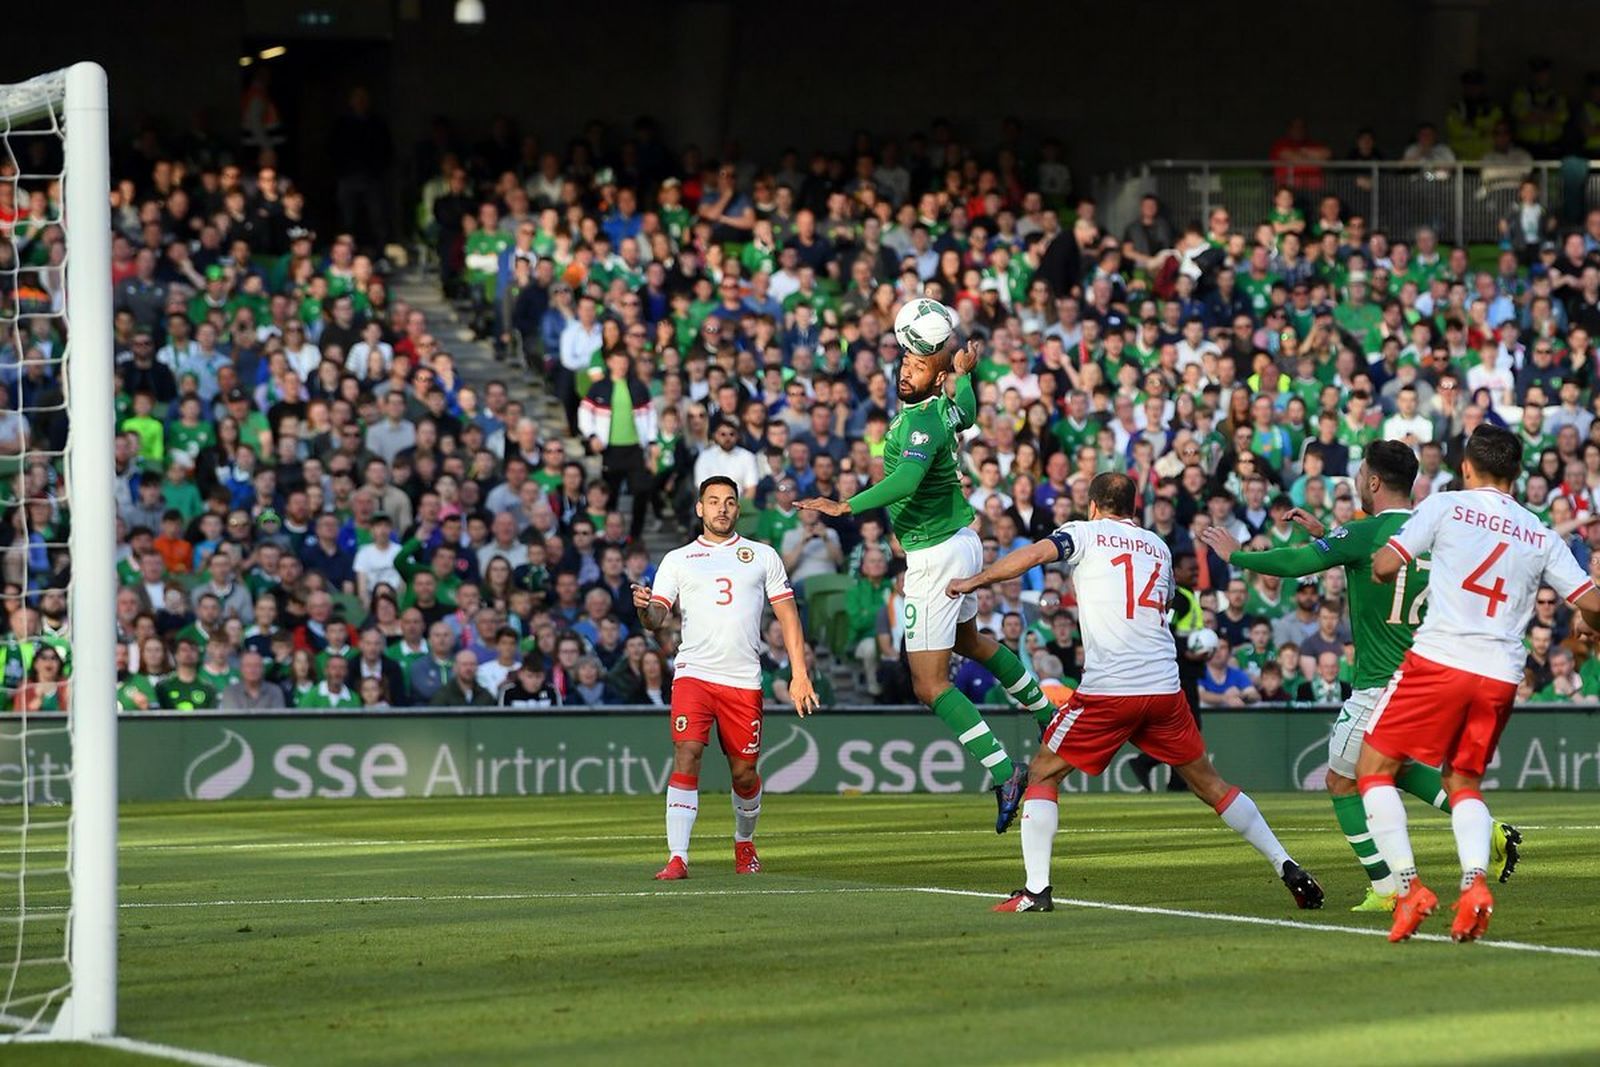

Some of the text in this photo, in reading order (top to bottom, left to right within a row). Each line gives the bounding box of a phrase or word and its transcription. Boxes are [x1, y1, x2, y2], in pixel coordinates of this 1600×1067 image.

[1452, 505, 1547, 549] SERGEANT
[715, 577, 733, 606] 3
[1110, 553, 1165, 619] 14
[1461, 541, 1510, 617] 4
[904, 603, 917, 629] 9
[748, 719, 760, 748] 3
[273, 743, 407, 799] sse
[837, 739, 965, 793] sse
